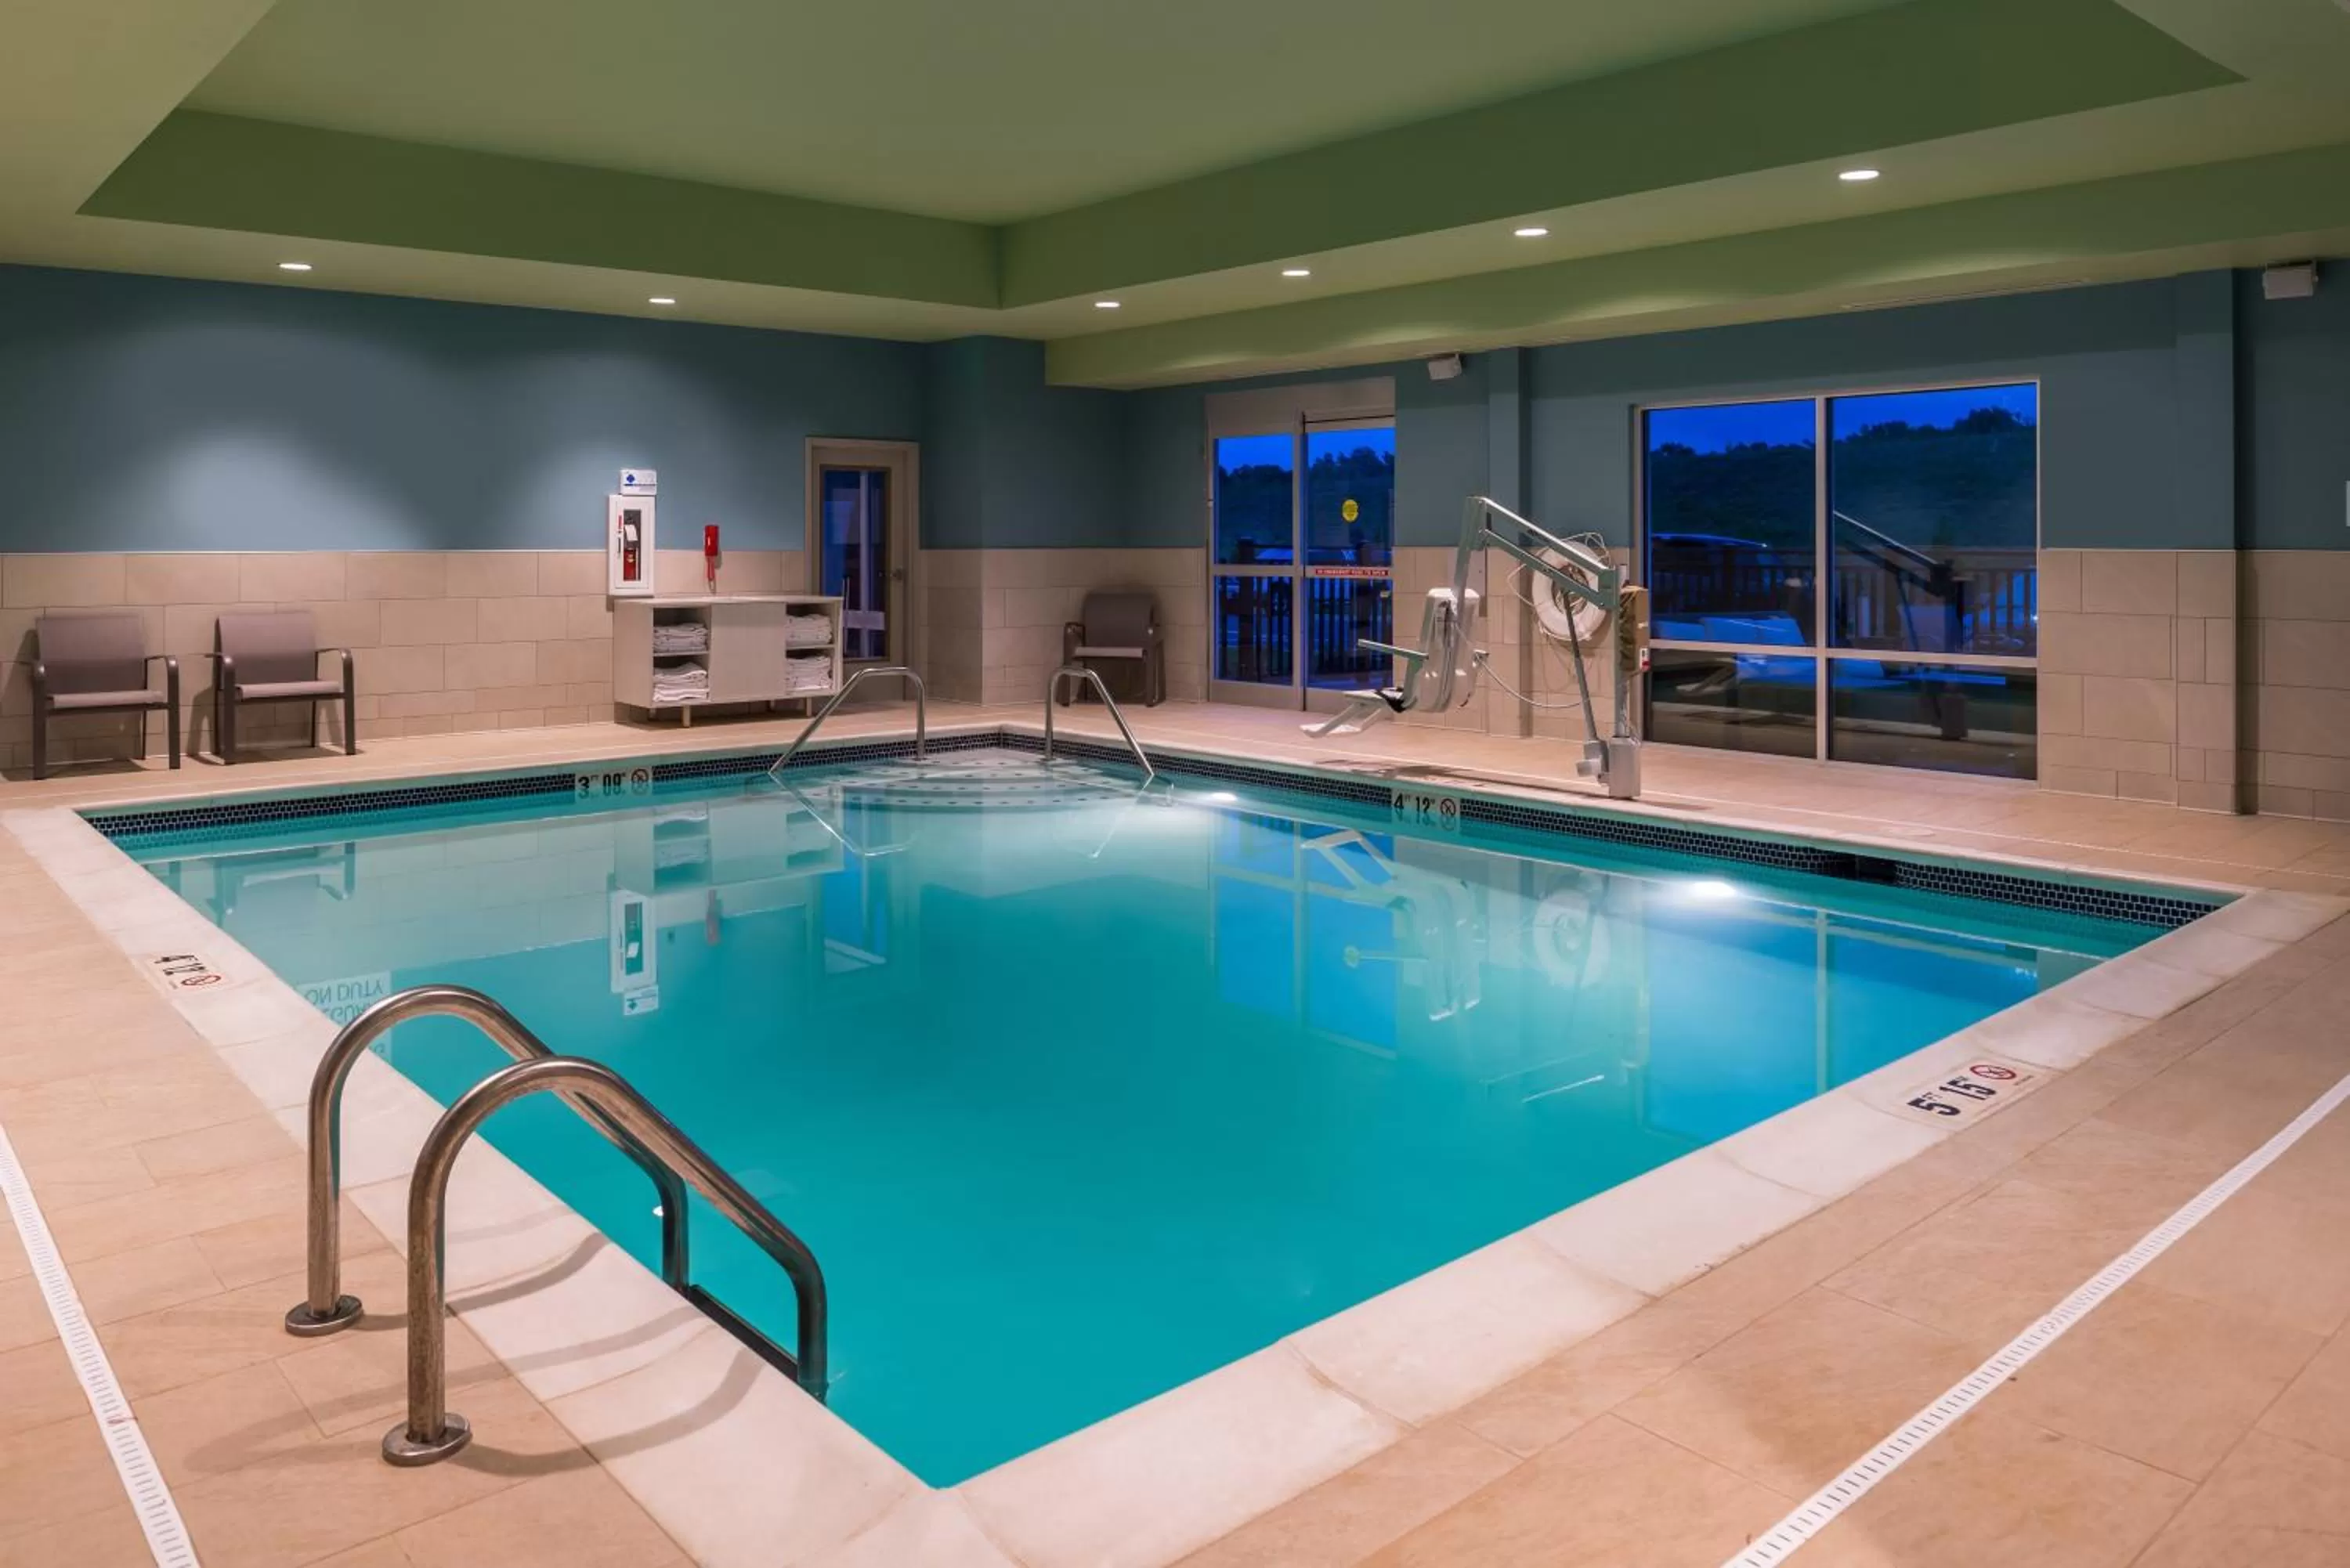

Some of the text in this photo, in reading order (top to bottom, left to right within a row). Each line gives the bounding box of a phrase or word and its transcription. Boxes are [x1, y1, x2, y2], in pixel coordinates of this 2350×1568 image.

[578, 776, 590, 789] 3
[1394, 793, 1405, 809] 4
[1907, 1097, 1961, 1116] 5
[1939, 1080, 1997, 1100] 15
